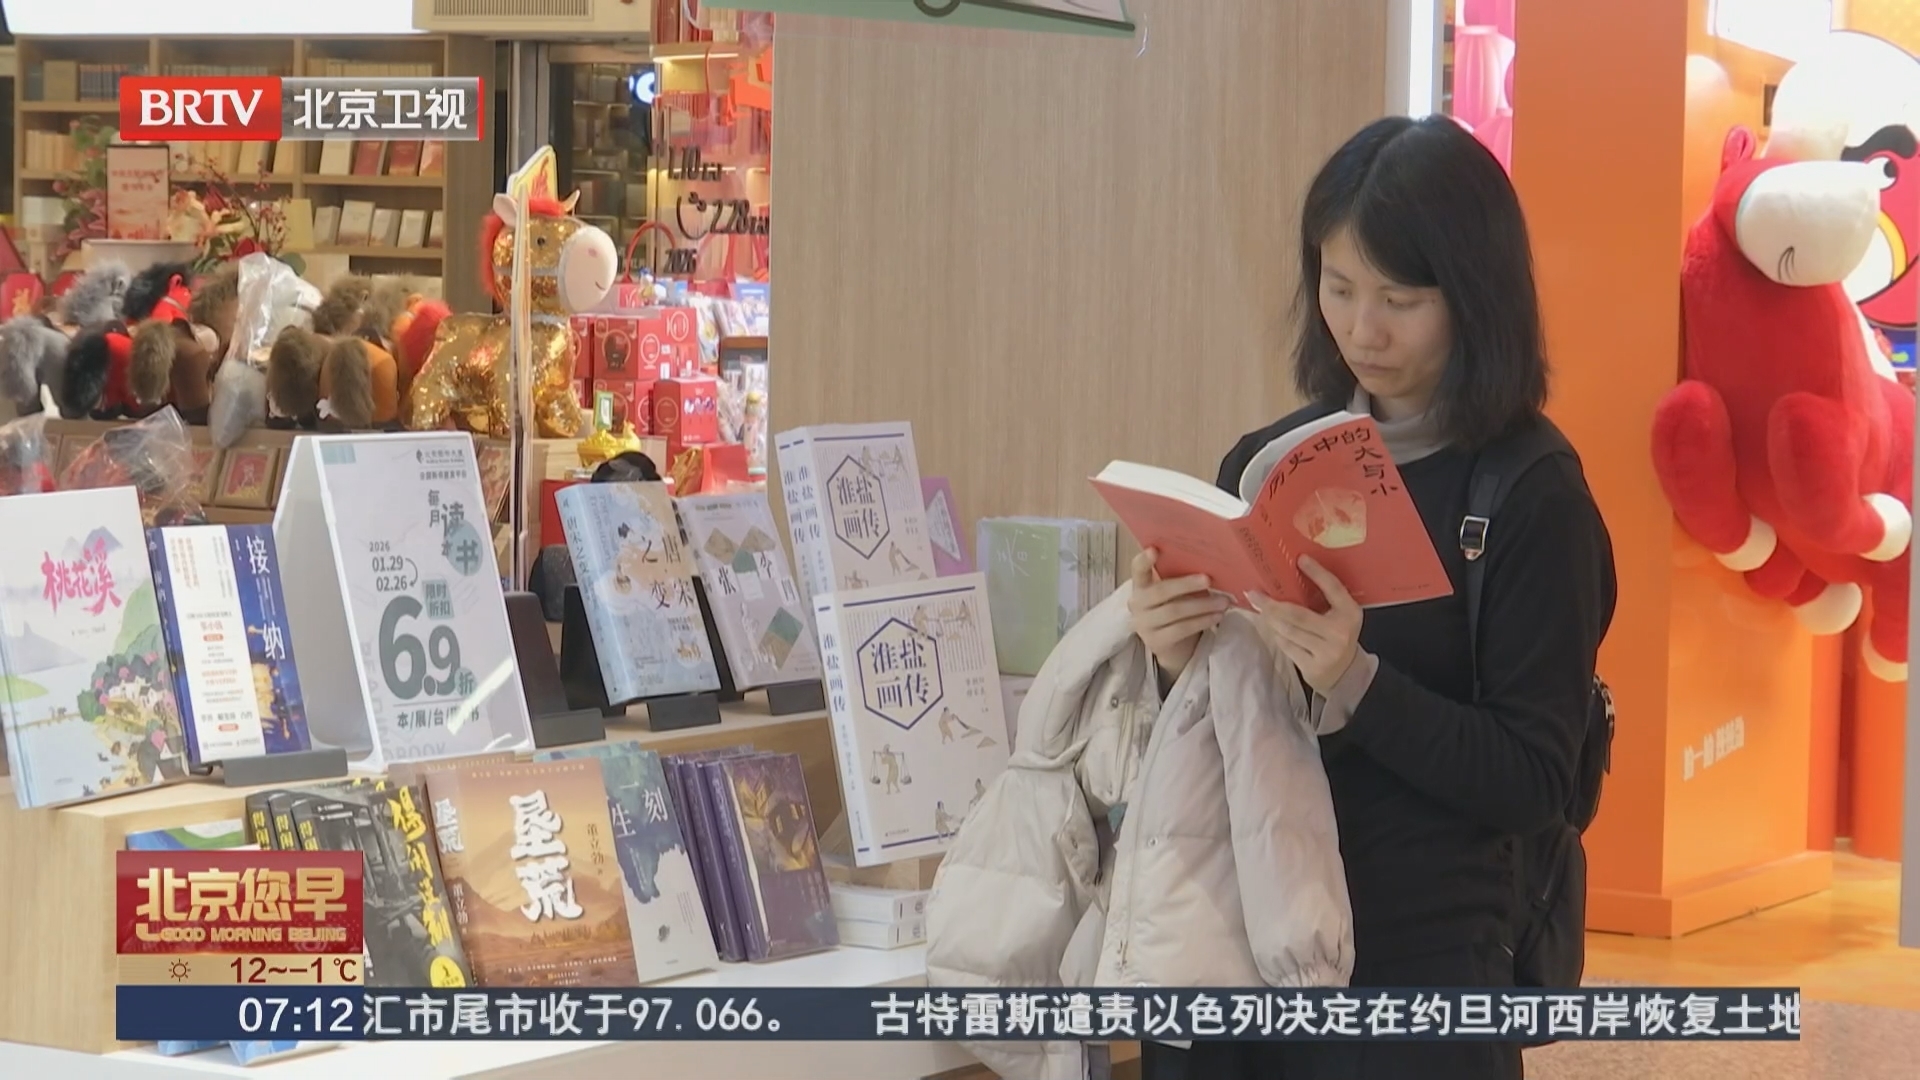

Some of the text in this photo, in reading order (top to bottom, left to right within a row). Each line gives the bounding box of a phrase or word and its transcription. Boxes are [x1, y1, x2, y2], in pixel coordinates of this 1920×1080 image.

[836, 472, 876, 506] 淮盐
[843, 508, 880, 539] 画传
[369, 541, 391, 553] 2026
[41, 536, 122, 616] 桃花溪
[372, 556, 404, 573] 01.29
[376, 575, 408, 592] 02.26
[425, 583, 447, 599] 限时
[429, 600, 451, 617] 折扣
[378, 594, 475, 700] 6.9 折
[871, 637, 927, 674] 淮盐
[823, 633, 846, 713] 淮盐画传
[875, 673, 929, 710] 画传
[509, 789, 584, 923] 垦荒
